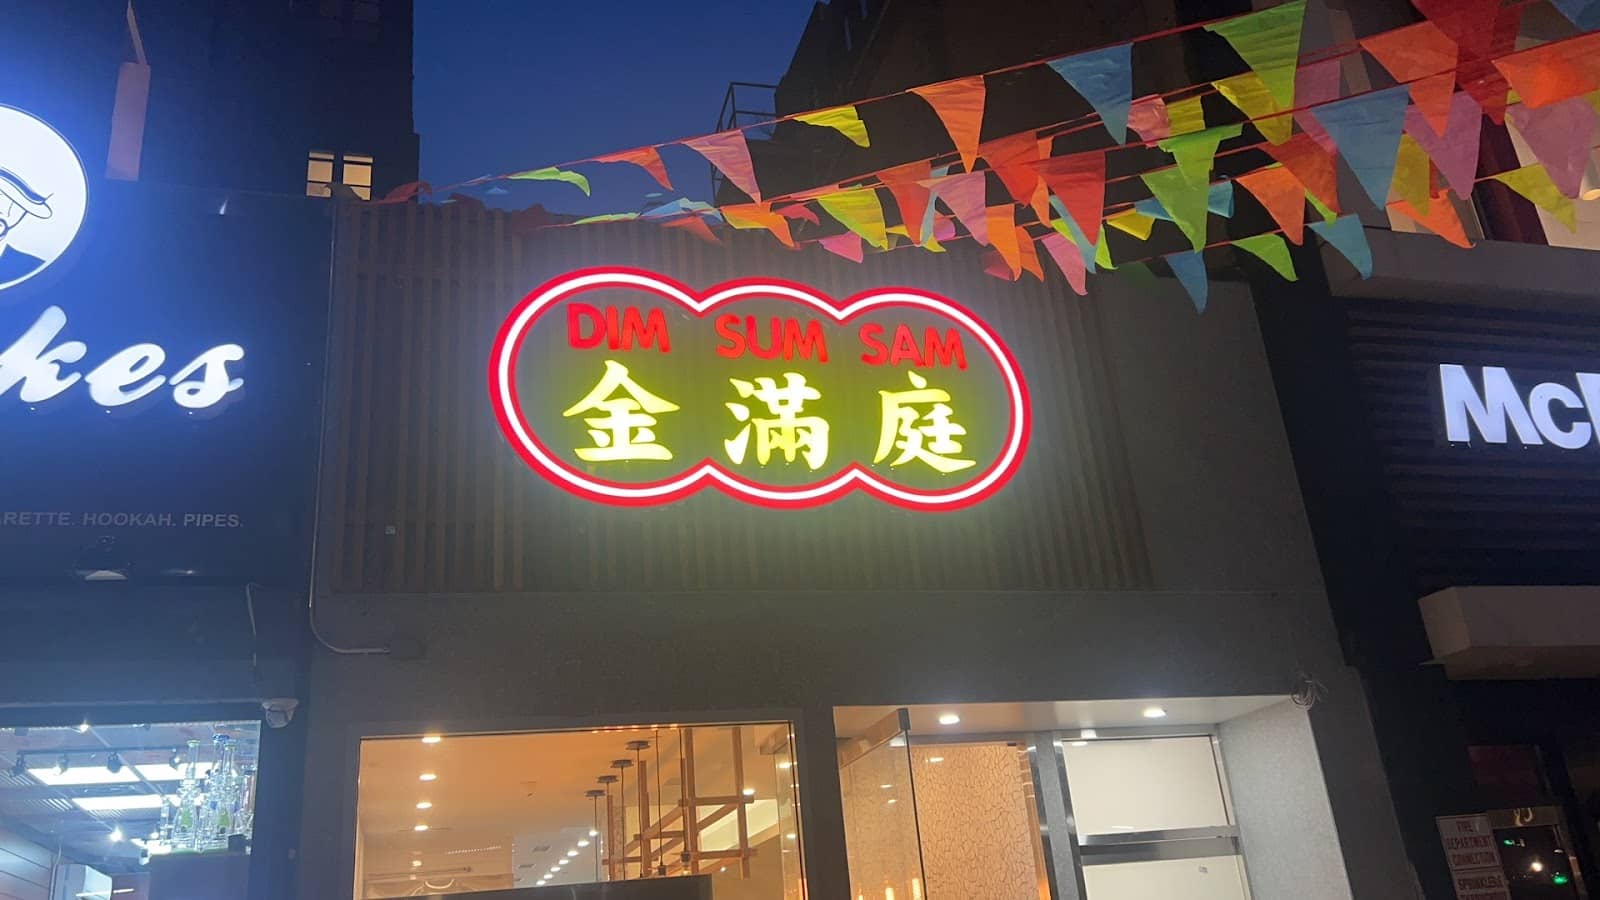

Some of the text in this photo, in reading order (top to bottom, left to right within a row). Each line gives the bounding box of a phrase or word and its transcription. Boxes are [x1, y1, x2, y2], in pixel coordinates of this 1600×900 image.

[567, 303, 968, 370] DIM SUM SAM
[562, 360, 977, 473] 金滿庭
[0, 512, 244, 528] RETTE. HOOKAH. PIPES.
